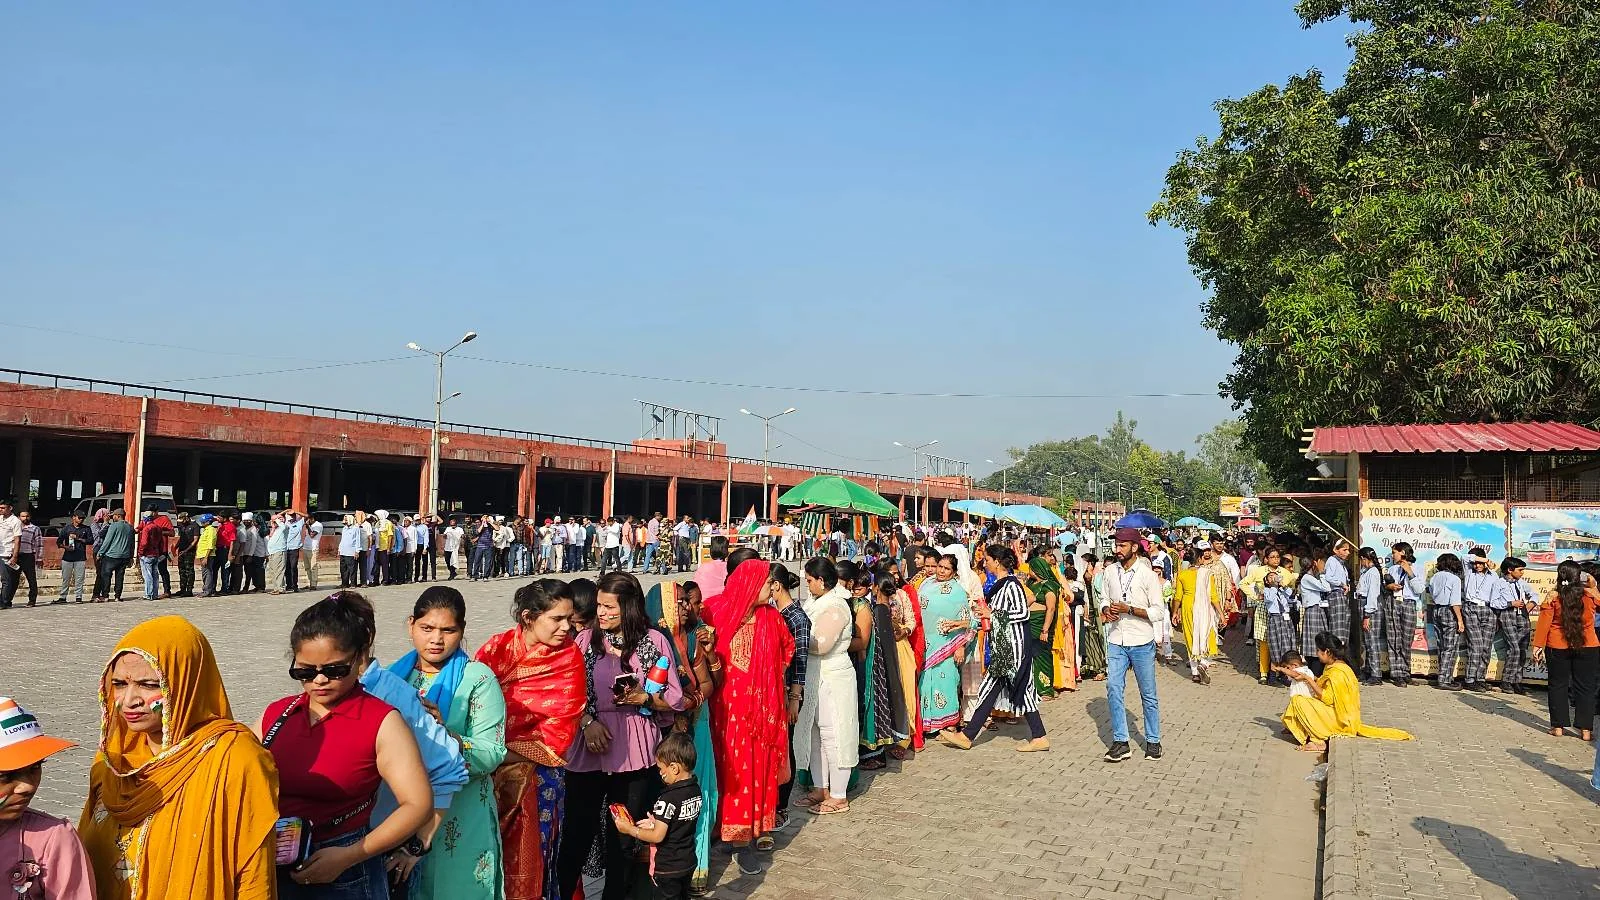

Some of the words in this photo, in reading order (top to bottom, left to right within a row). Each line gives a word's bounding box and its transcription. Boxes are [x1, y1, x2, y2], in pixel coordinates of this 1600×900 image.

[1369, 507, 1391, 517] YOUR
[1393, 507, 1413, 518] FREE
[1414, 508, 1441, 518] GUIDE
[1442, 508, 1452, 518] IN
[1453, 509, 1498, 519] AMRITSAR
[1371, 522, 1384, 533] Ho
[1388, 522, 1402, 534] Ho
[1416, 524, 1440, 537] Sang
[1411, 539, 1450, 550] Amritsar
[9, 725, 25, 734] LOVE
[262, 722, 282, 745] YOUNG
